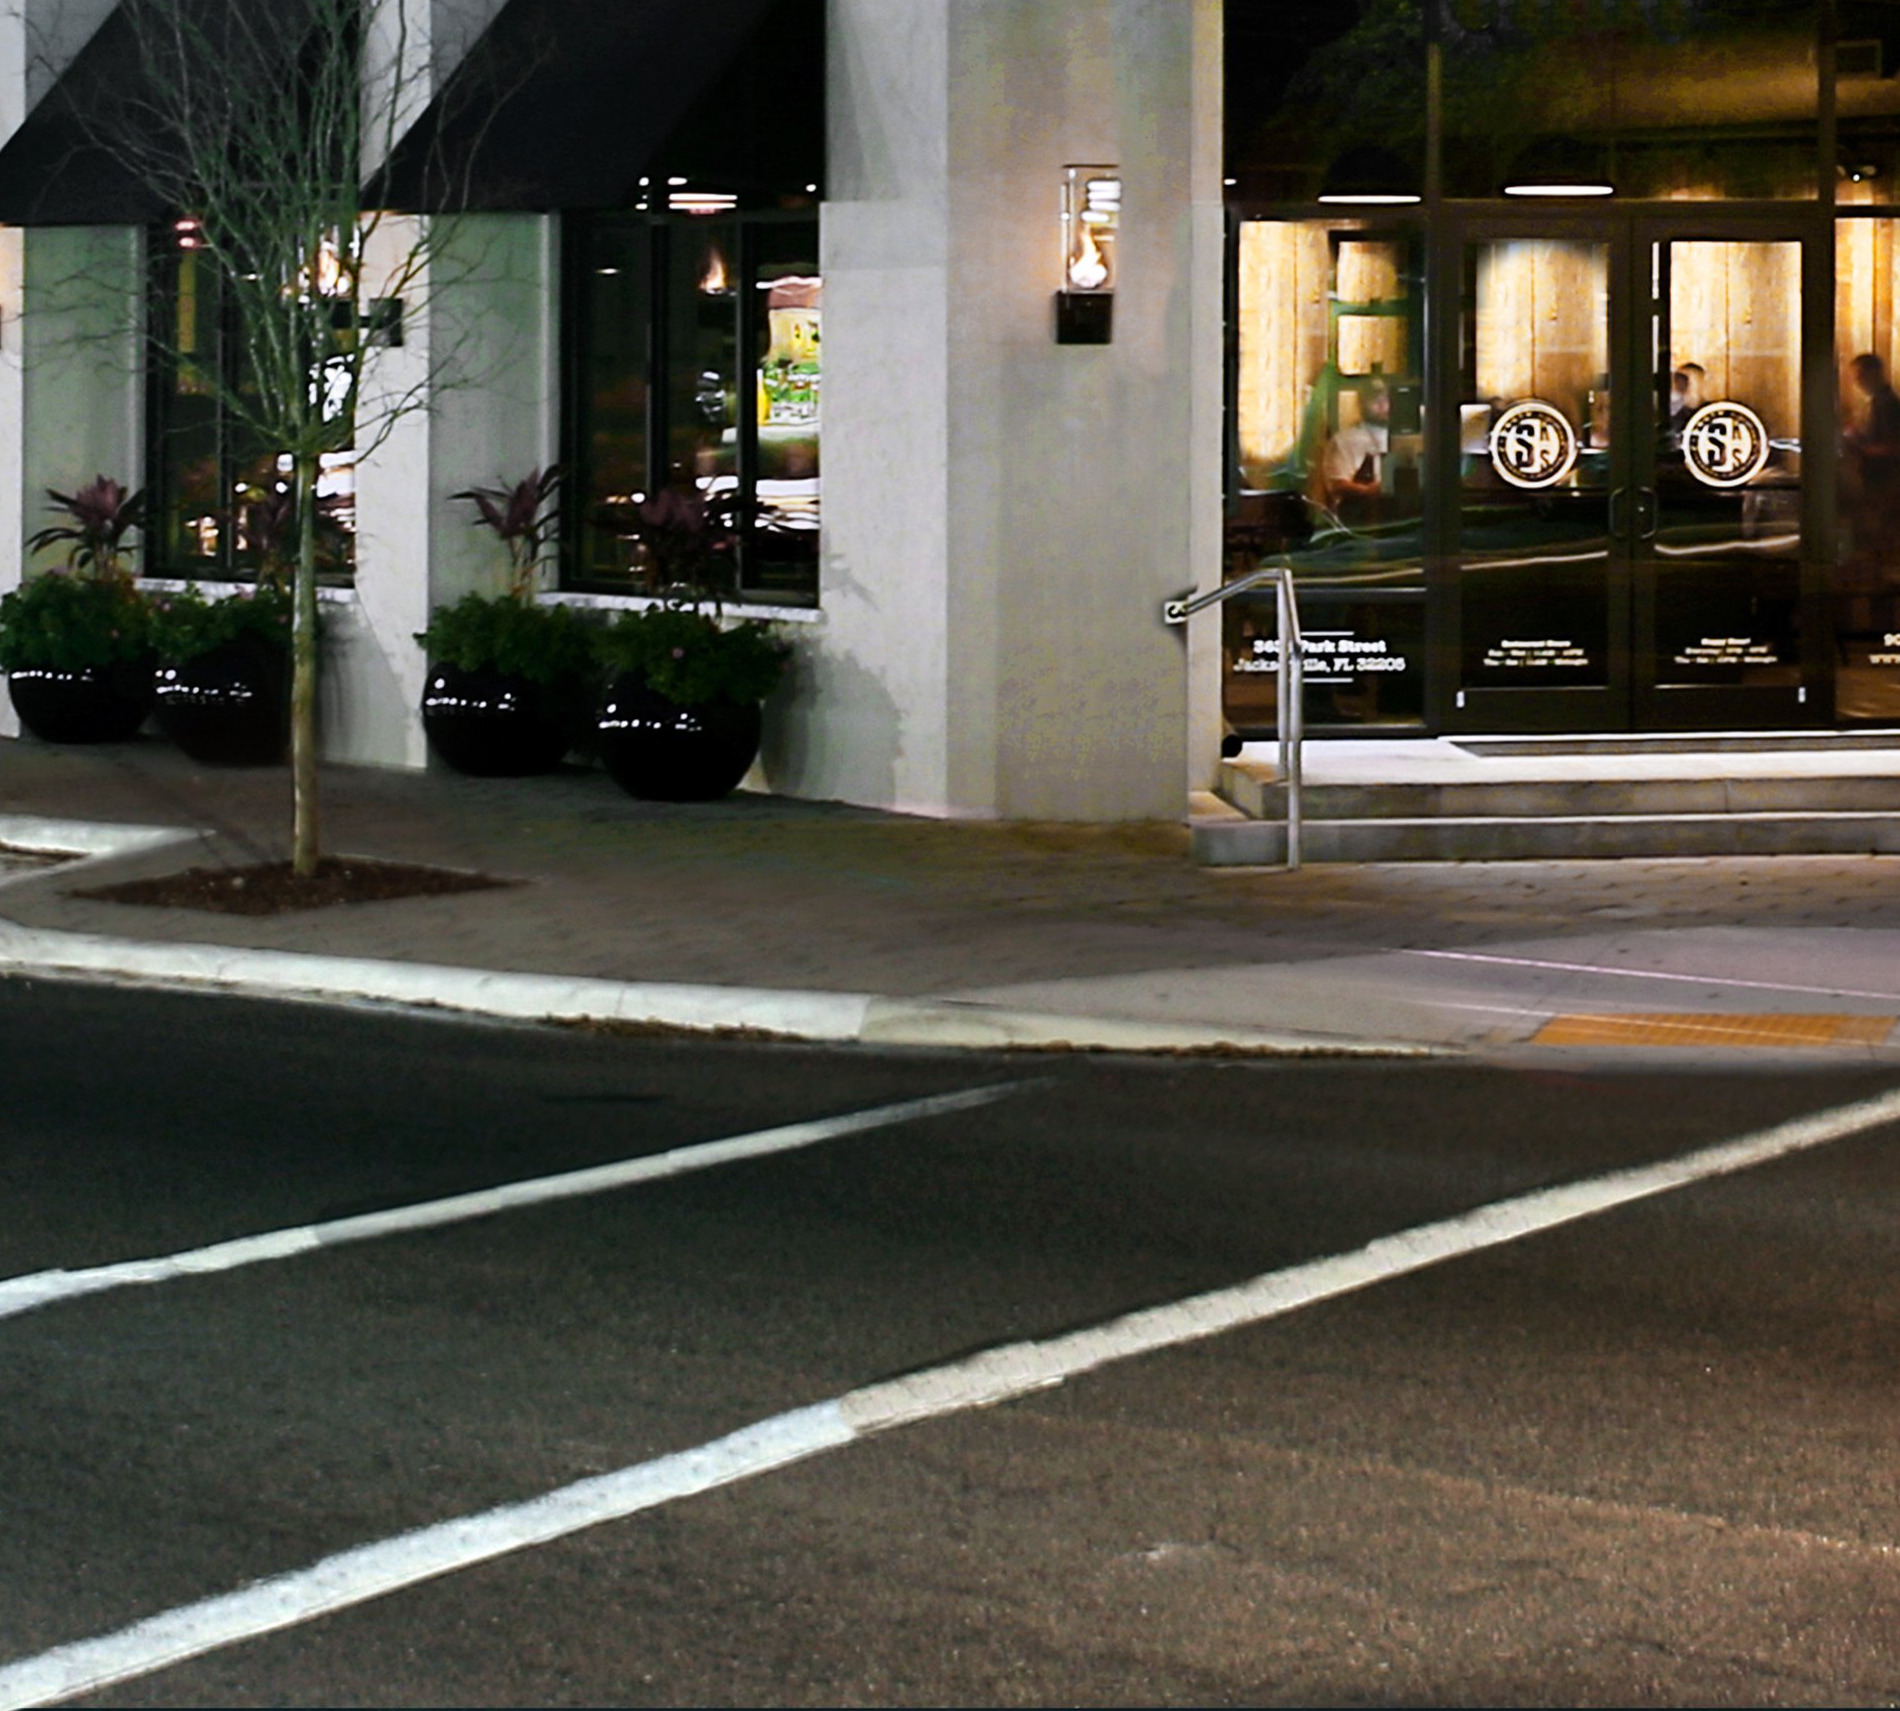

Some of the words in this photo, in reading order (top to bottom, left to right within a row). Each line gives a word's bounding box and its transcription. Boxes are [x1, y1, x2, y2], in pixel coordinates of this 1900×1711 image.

[1253, 640, 1294, 653] 363
[1337, 639, 1387, 653] Street
[1333, 658, 1354, 672] FL
